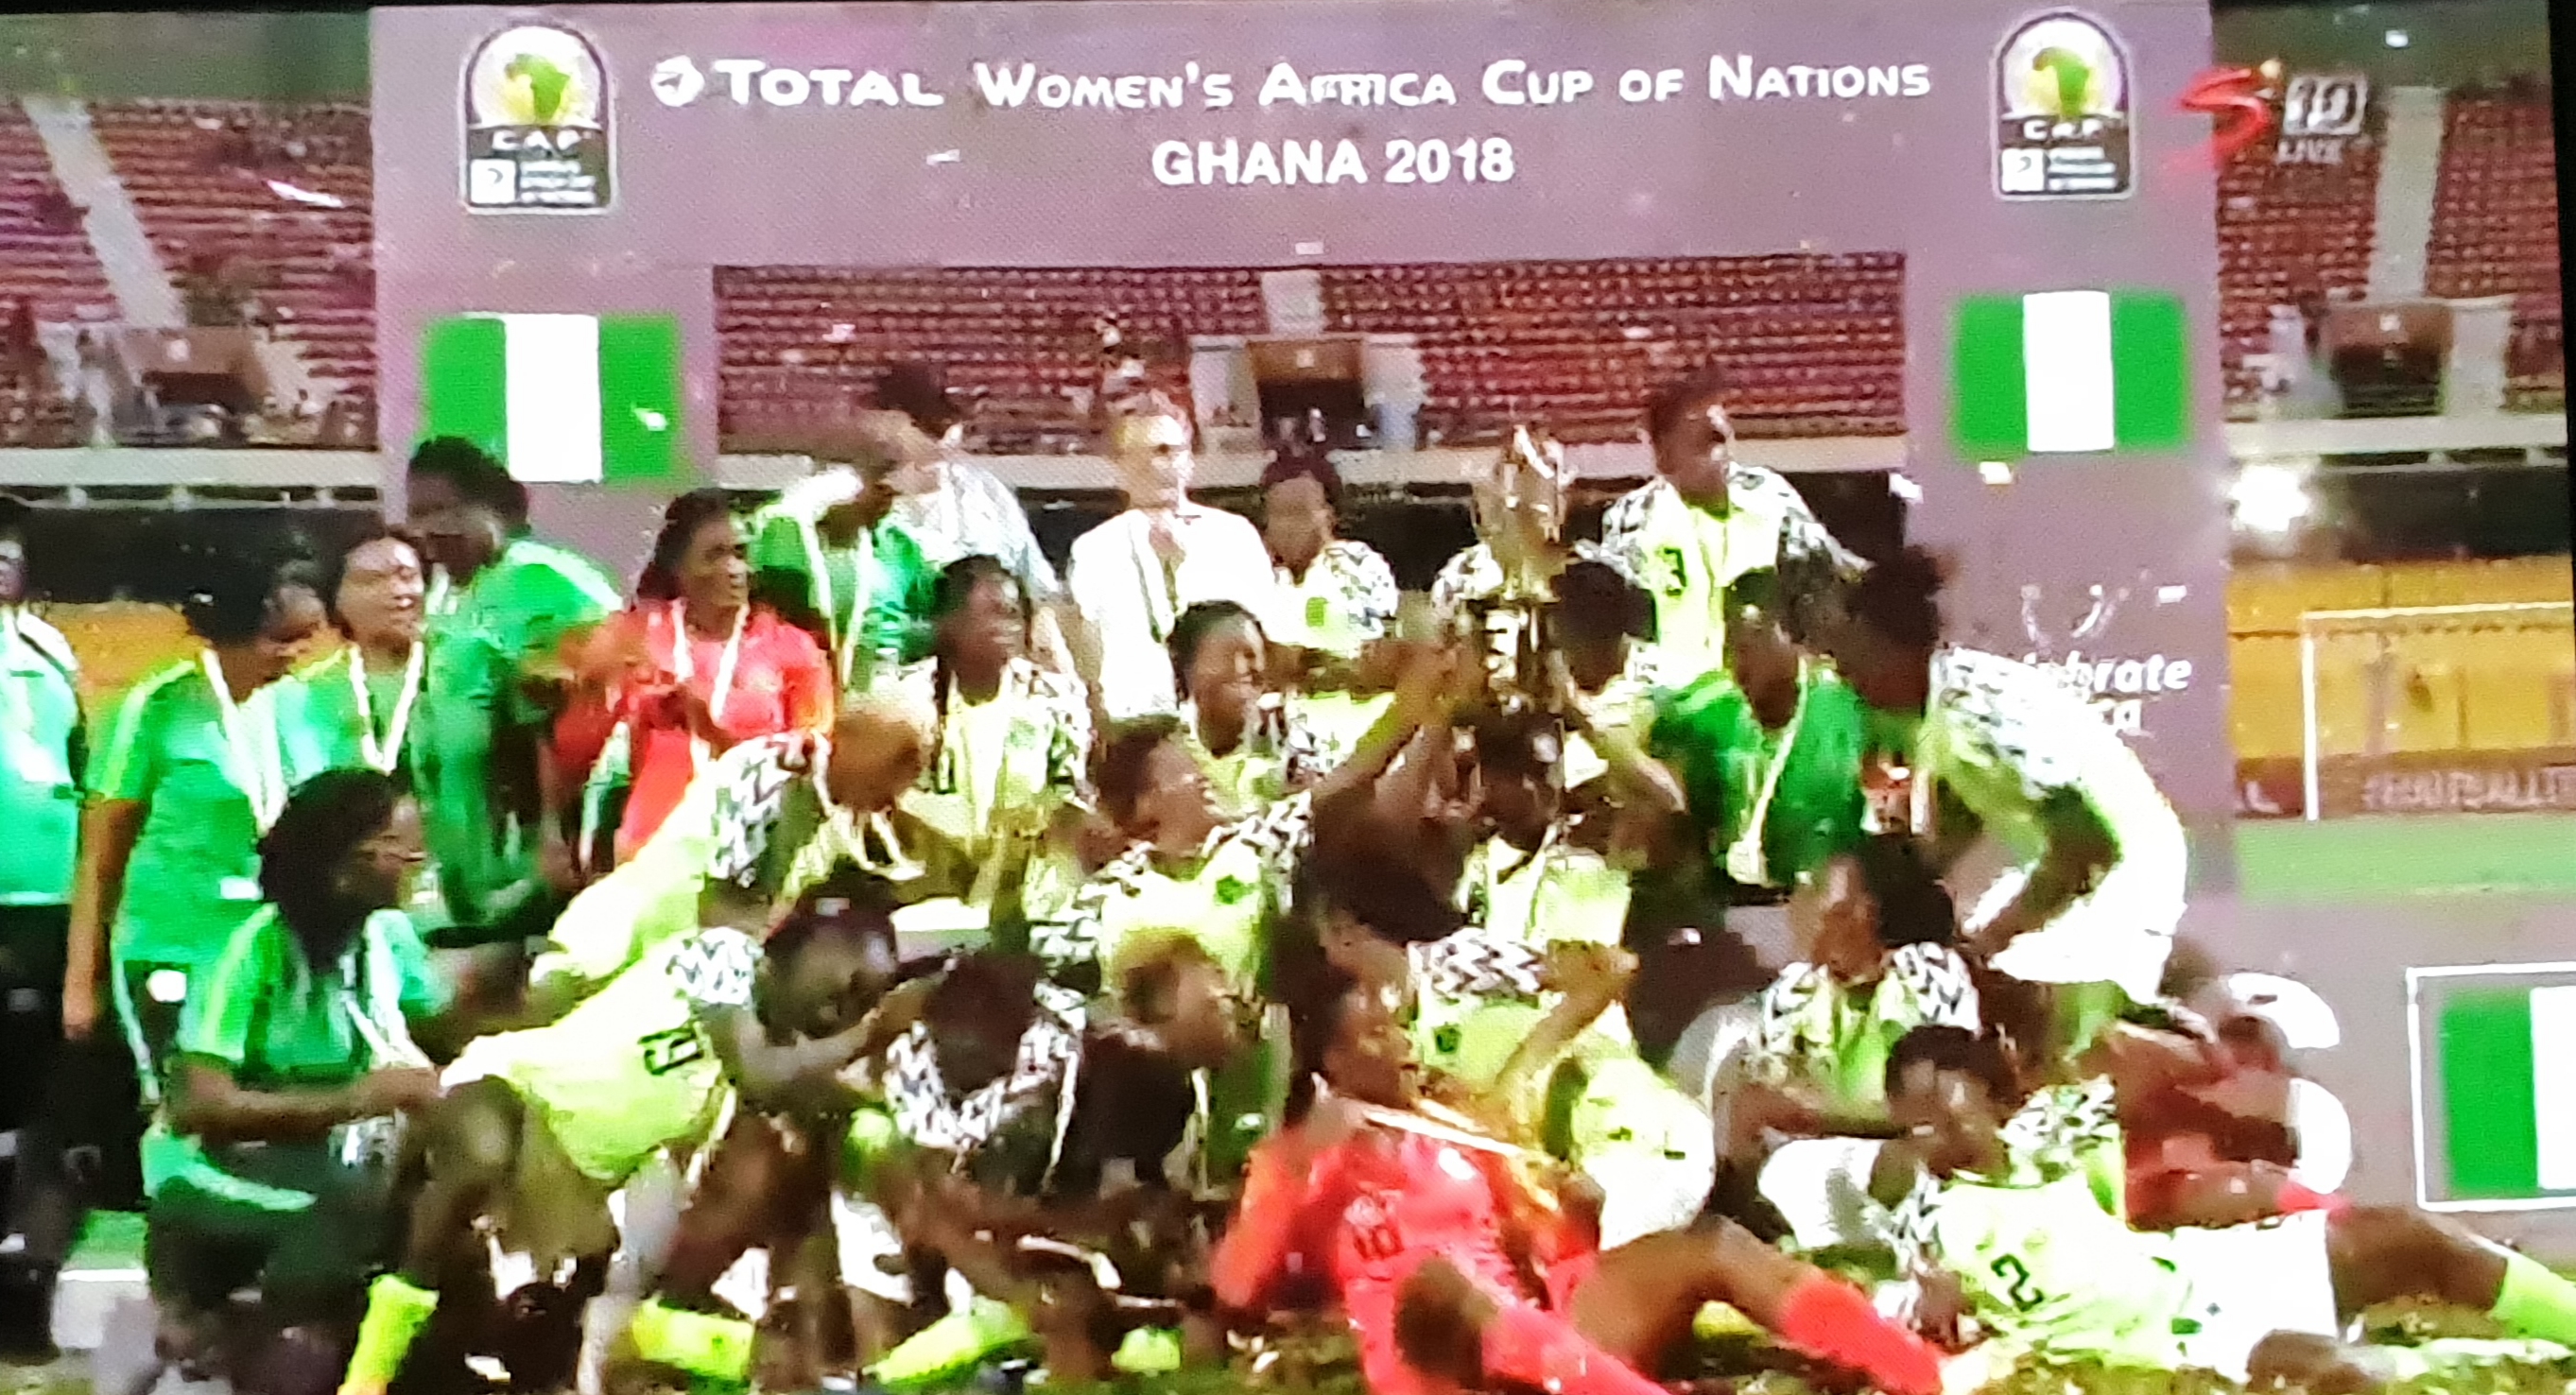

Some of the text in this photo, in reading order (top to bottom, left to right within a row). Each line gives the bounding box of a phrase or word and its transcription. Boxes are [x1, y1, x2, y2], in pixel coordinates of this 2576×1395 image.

[713, 55, 1931, 109] TOTAL WOMEN'S AFRICA CUP OF NATIONS
[1150, 137, 1514, 186] GHANA 2018
[1990, 1253, 2045, 1313] 2
